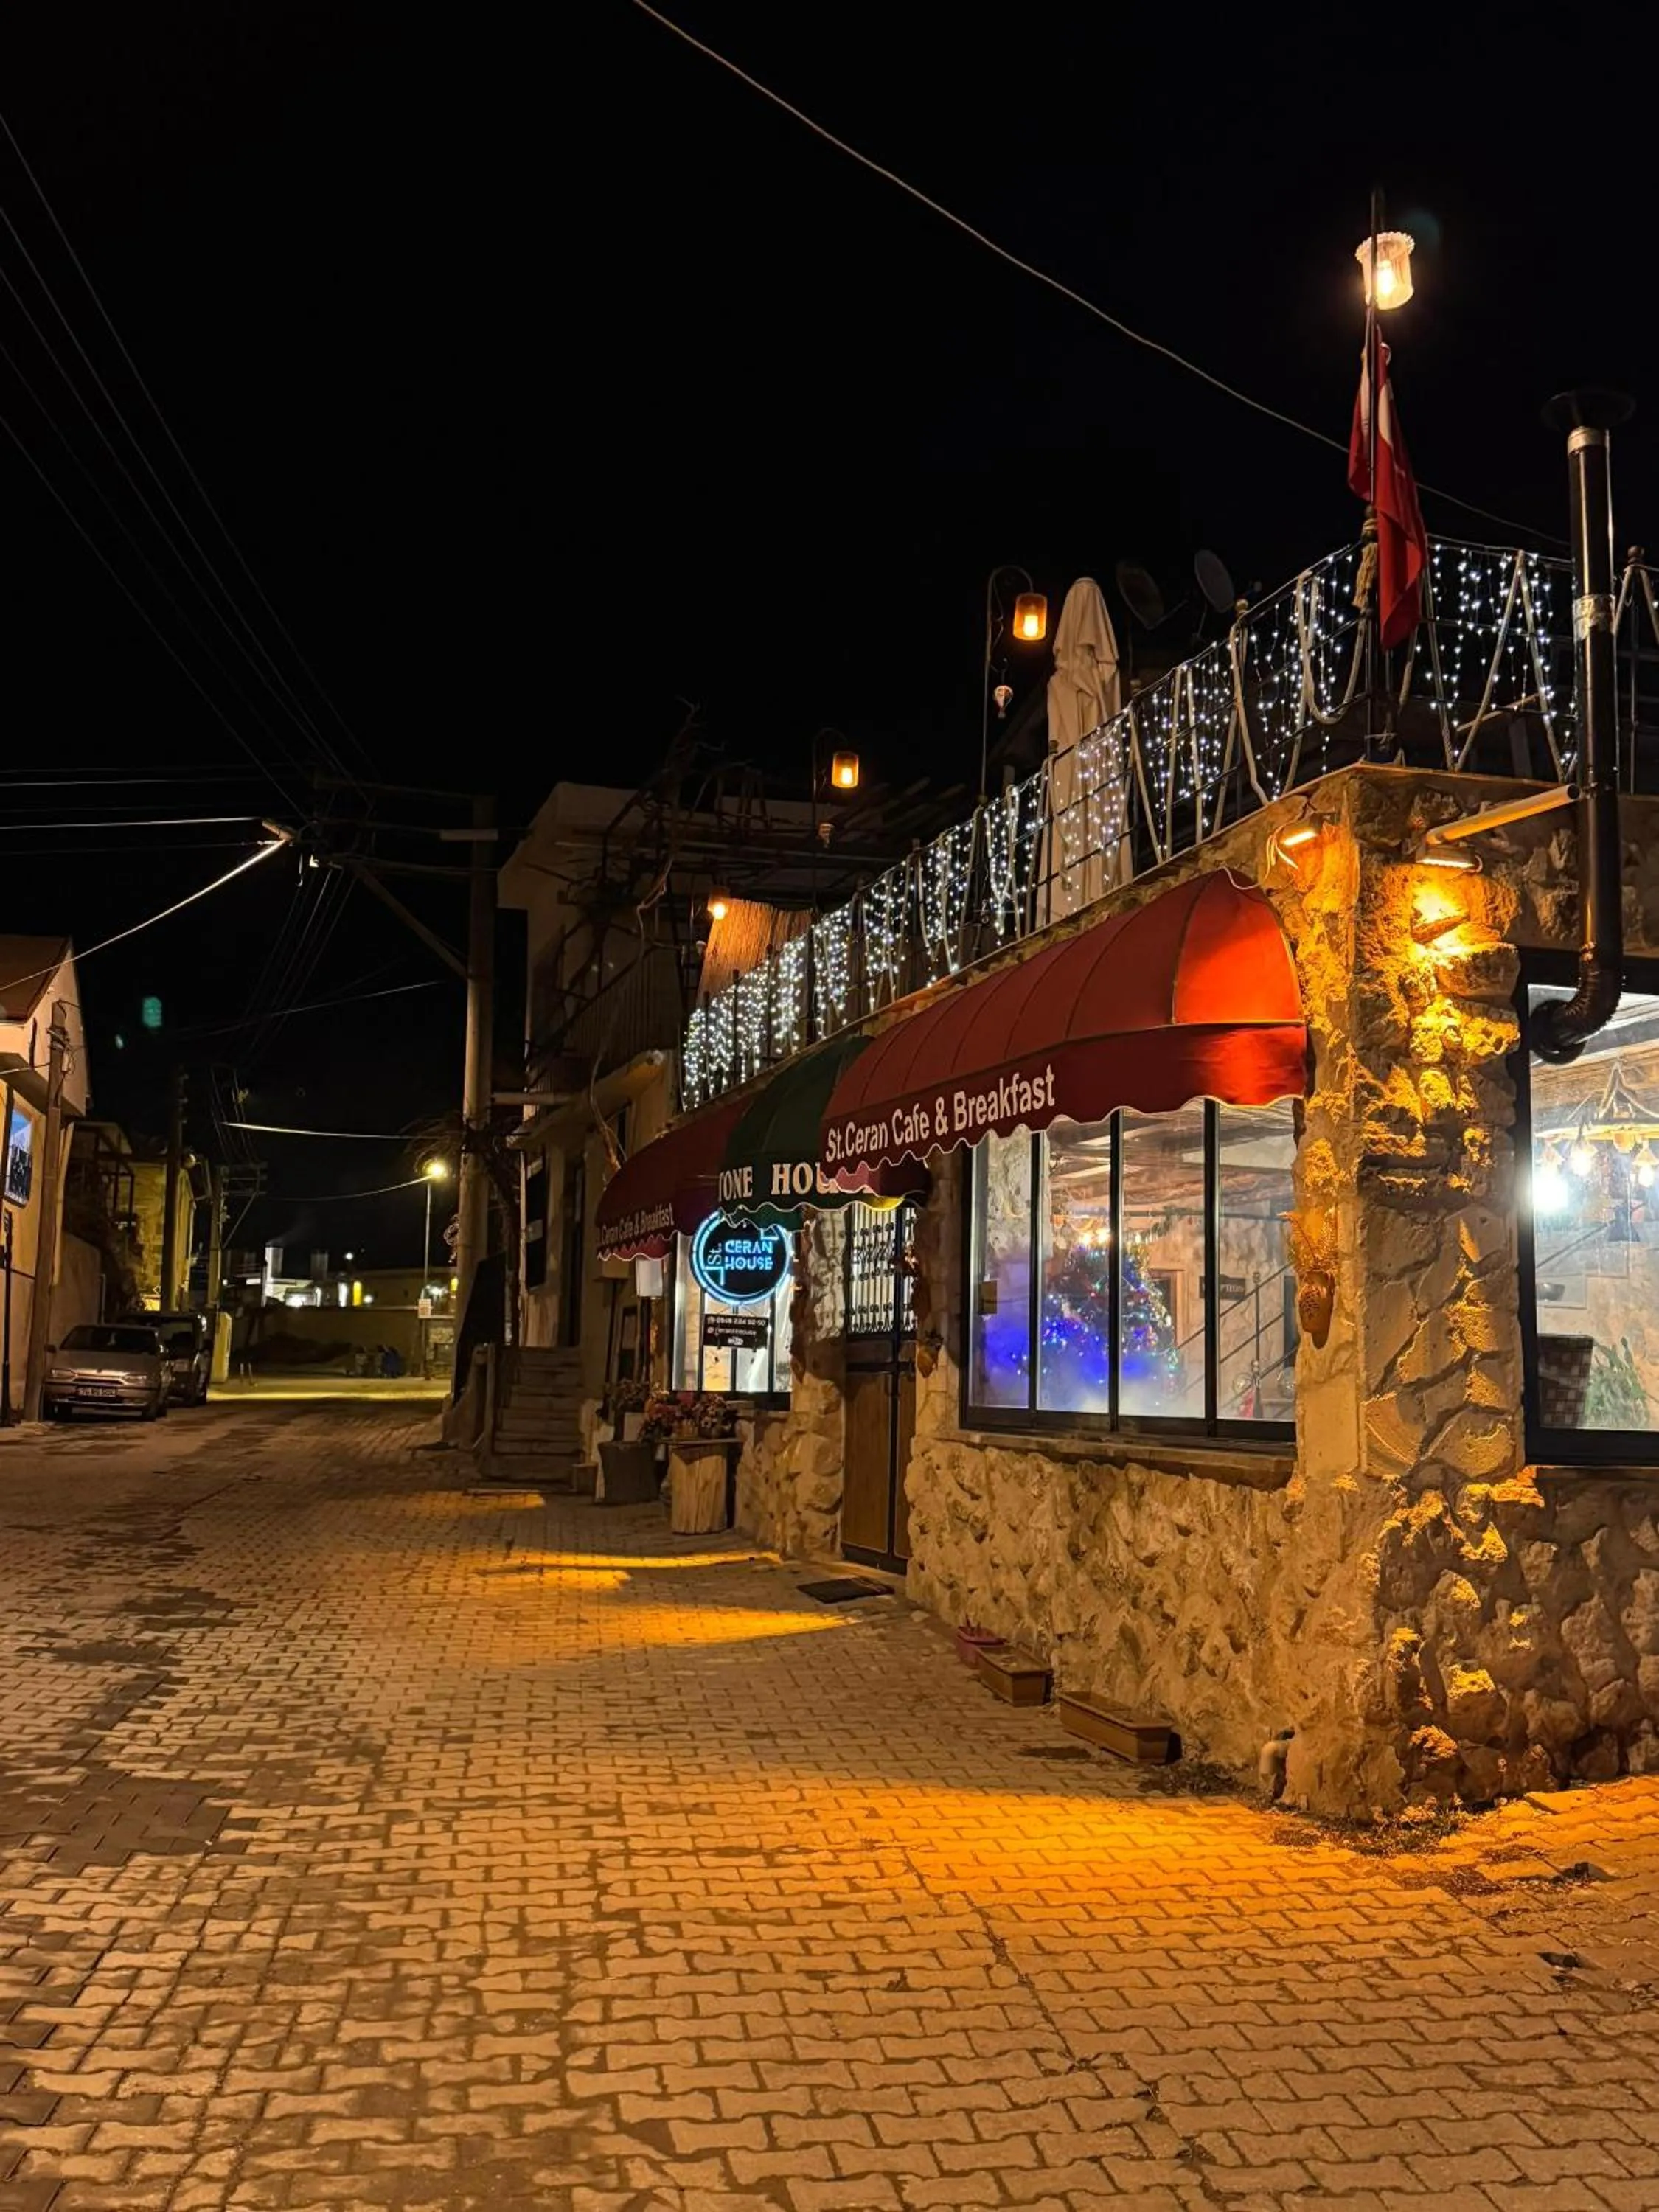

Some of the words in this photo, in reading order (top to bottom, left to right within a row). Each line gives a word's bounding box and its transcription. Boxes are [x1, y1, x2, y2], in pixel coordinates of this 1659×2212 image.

[891, 1102, 929, 1146] Cafe
[934, 1096, 949, 1135] &
[953, 1063, 1055, 1132] Breakfast
[718, 1166, 754, 1203] TONE
[771, 1161, 874, 1195] HOU
[708, 1242, 723, 1265] St.
[724, 1239, 773, 1254] CERAN
[724, 1256, 773, 1270] HOUSE
